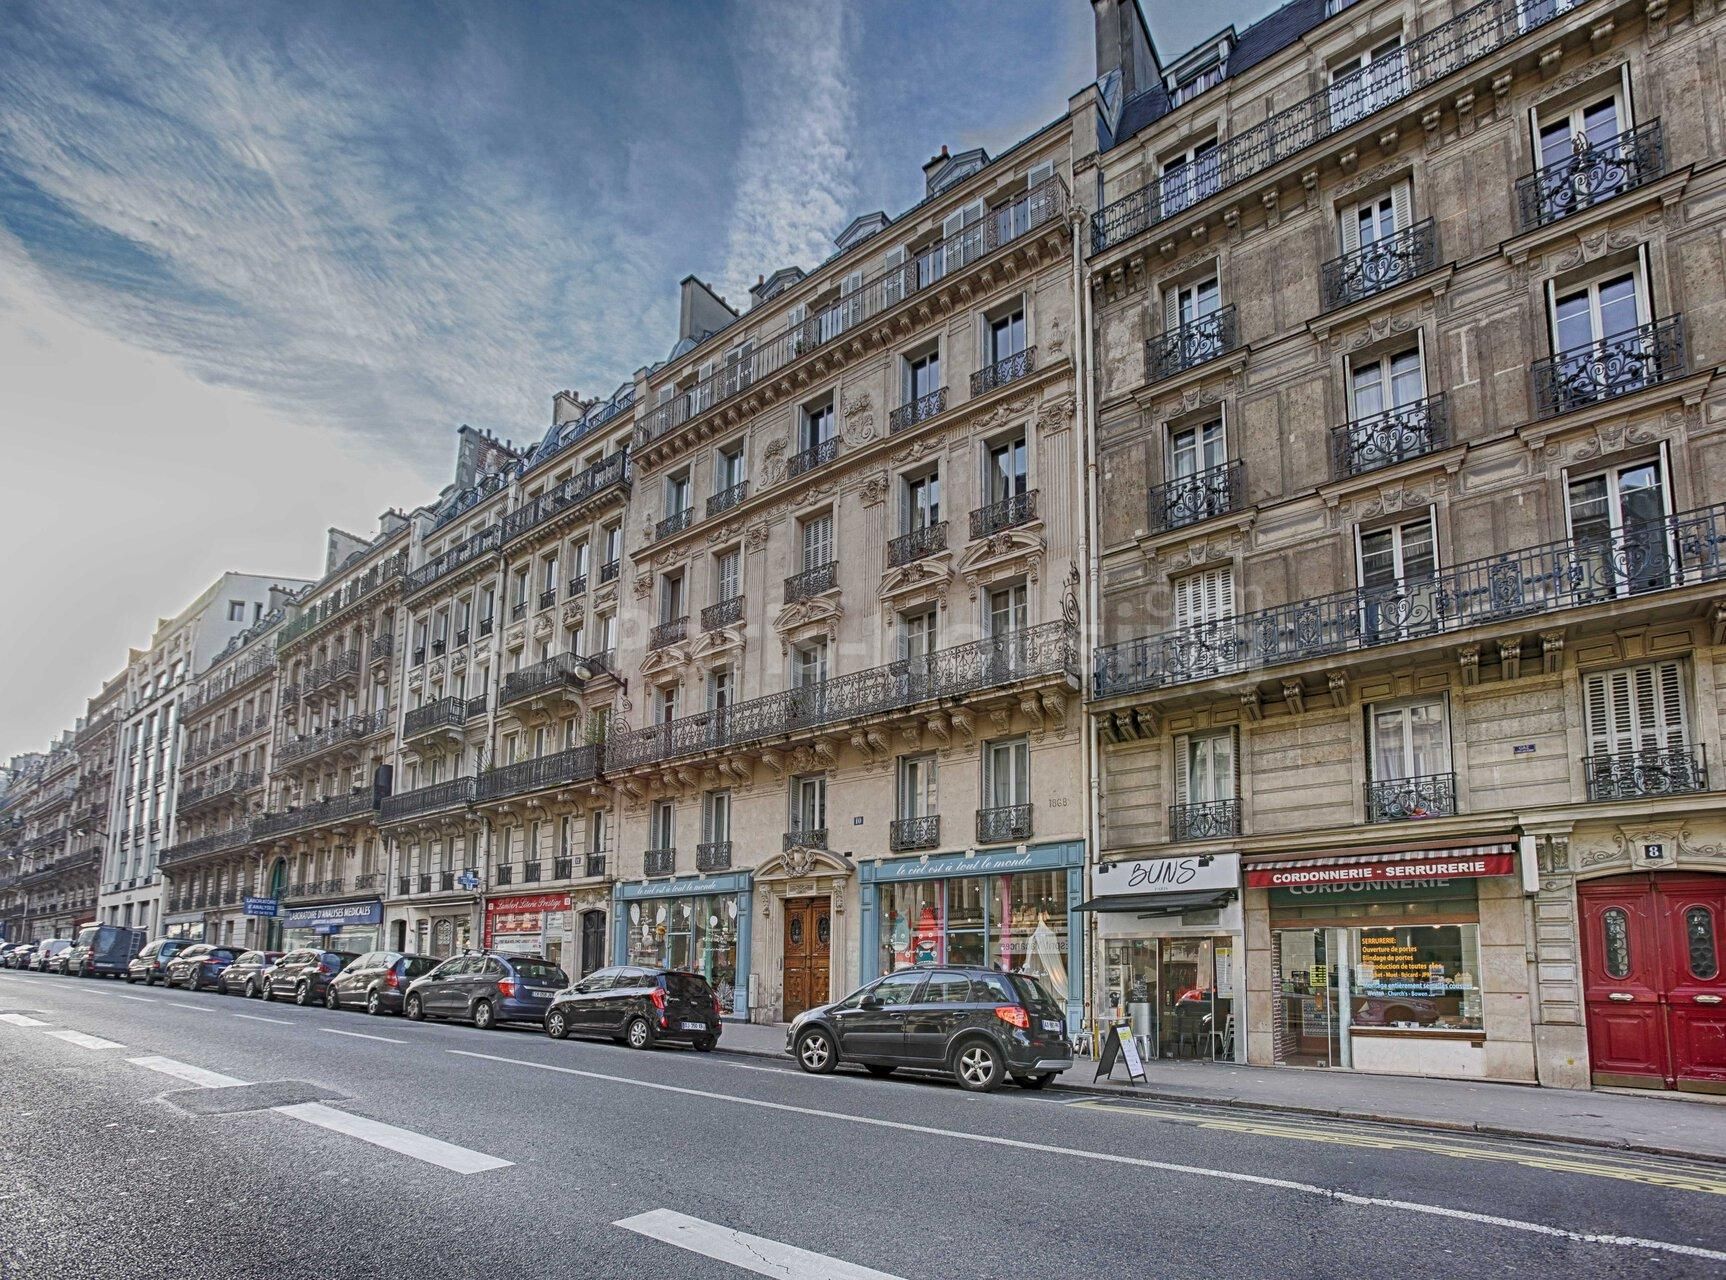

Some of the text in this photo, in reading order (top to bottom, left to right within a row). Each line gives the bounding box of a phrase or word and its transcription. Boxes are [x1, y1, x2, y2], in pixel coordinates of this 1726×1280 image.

[1648, 845, 1660, 858] 8
[895, 852, 1033, 876] le ciel est à tout le monde
[1128, 858, 1197, 887] BUNS
[1273, 868, 1372, 884] CORDONNERIE
[1385, 861, 1485, 877] SERRURERIE
[693, 880, 717, 891] monde
[289, 910, 317, 920] LABORATOIRE
[317, 907, 344, 919] D'ANALYSES
